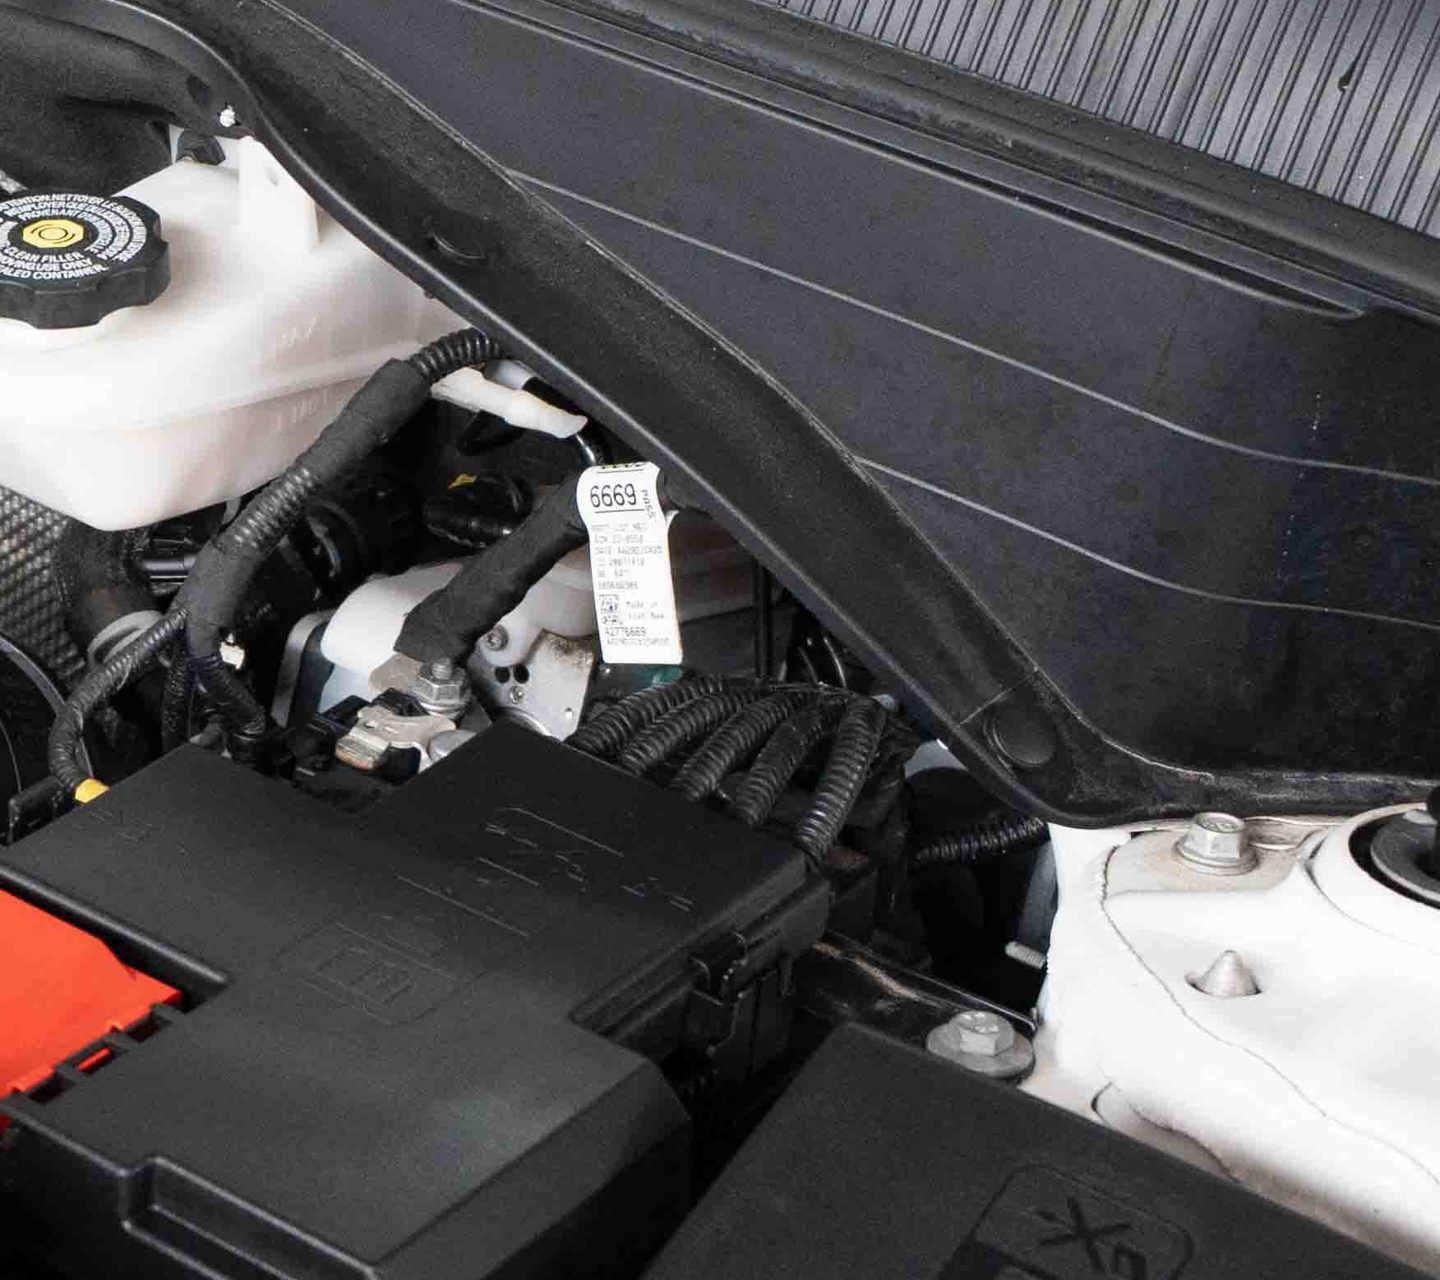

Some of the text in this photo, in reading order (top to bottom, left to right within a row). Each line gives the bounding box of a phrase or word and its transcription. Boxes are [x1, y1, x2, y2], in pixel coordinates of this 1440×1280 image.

[3, 246, 40, 262] CLEAN
[40, 250, 85, 263] FILLER
[36, 262, 61, 272] USE
[61, 257, 93, 270] ONLY
[590, 483, 637, 508] 6669
